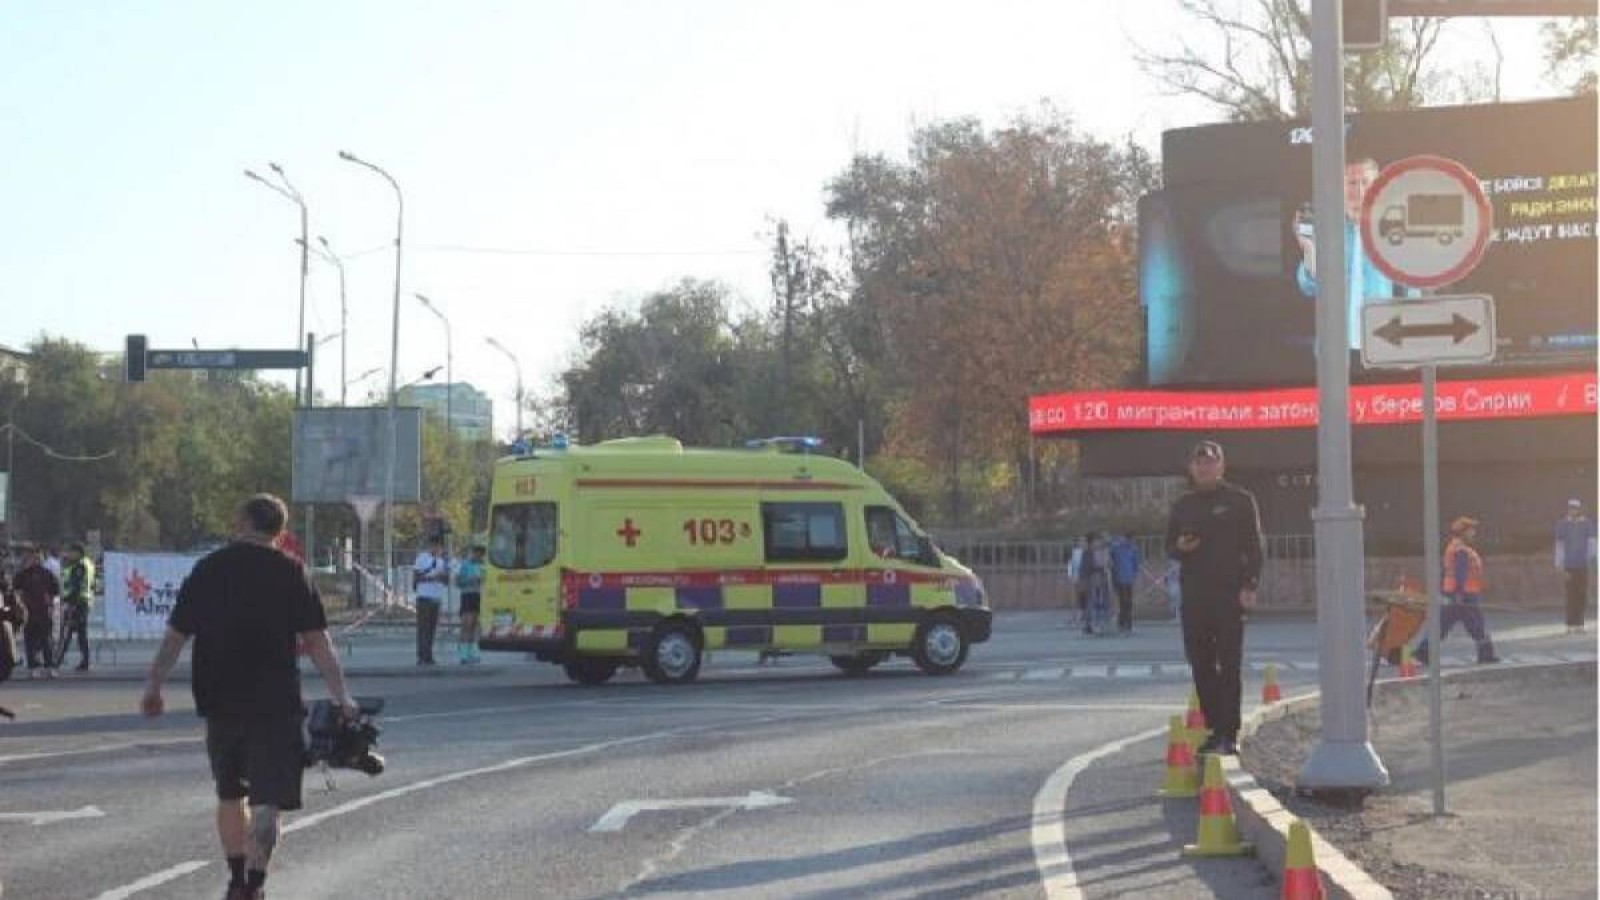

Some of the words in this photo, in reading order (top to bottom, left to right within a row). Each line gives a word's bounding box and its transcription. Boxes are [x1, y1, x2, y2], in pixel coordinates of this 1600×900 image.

[1073, 400, 1109, 421] 120
[1117, 403, 1253, 425] мигрантами
[1355, 399, 1366, 418] у
[1372, 395, 1457, 417] береов
[1462, 388, 1532, 413] Сирии
[683, 519, 736, 545] 103
